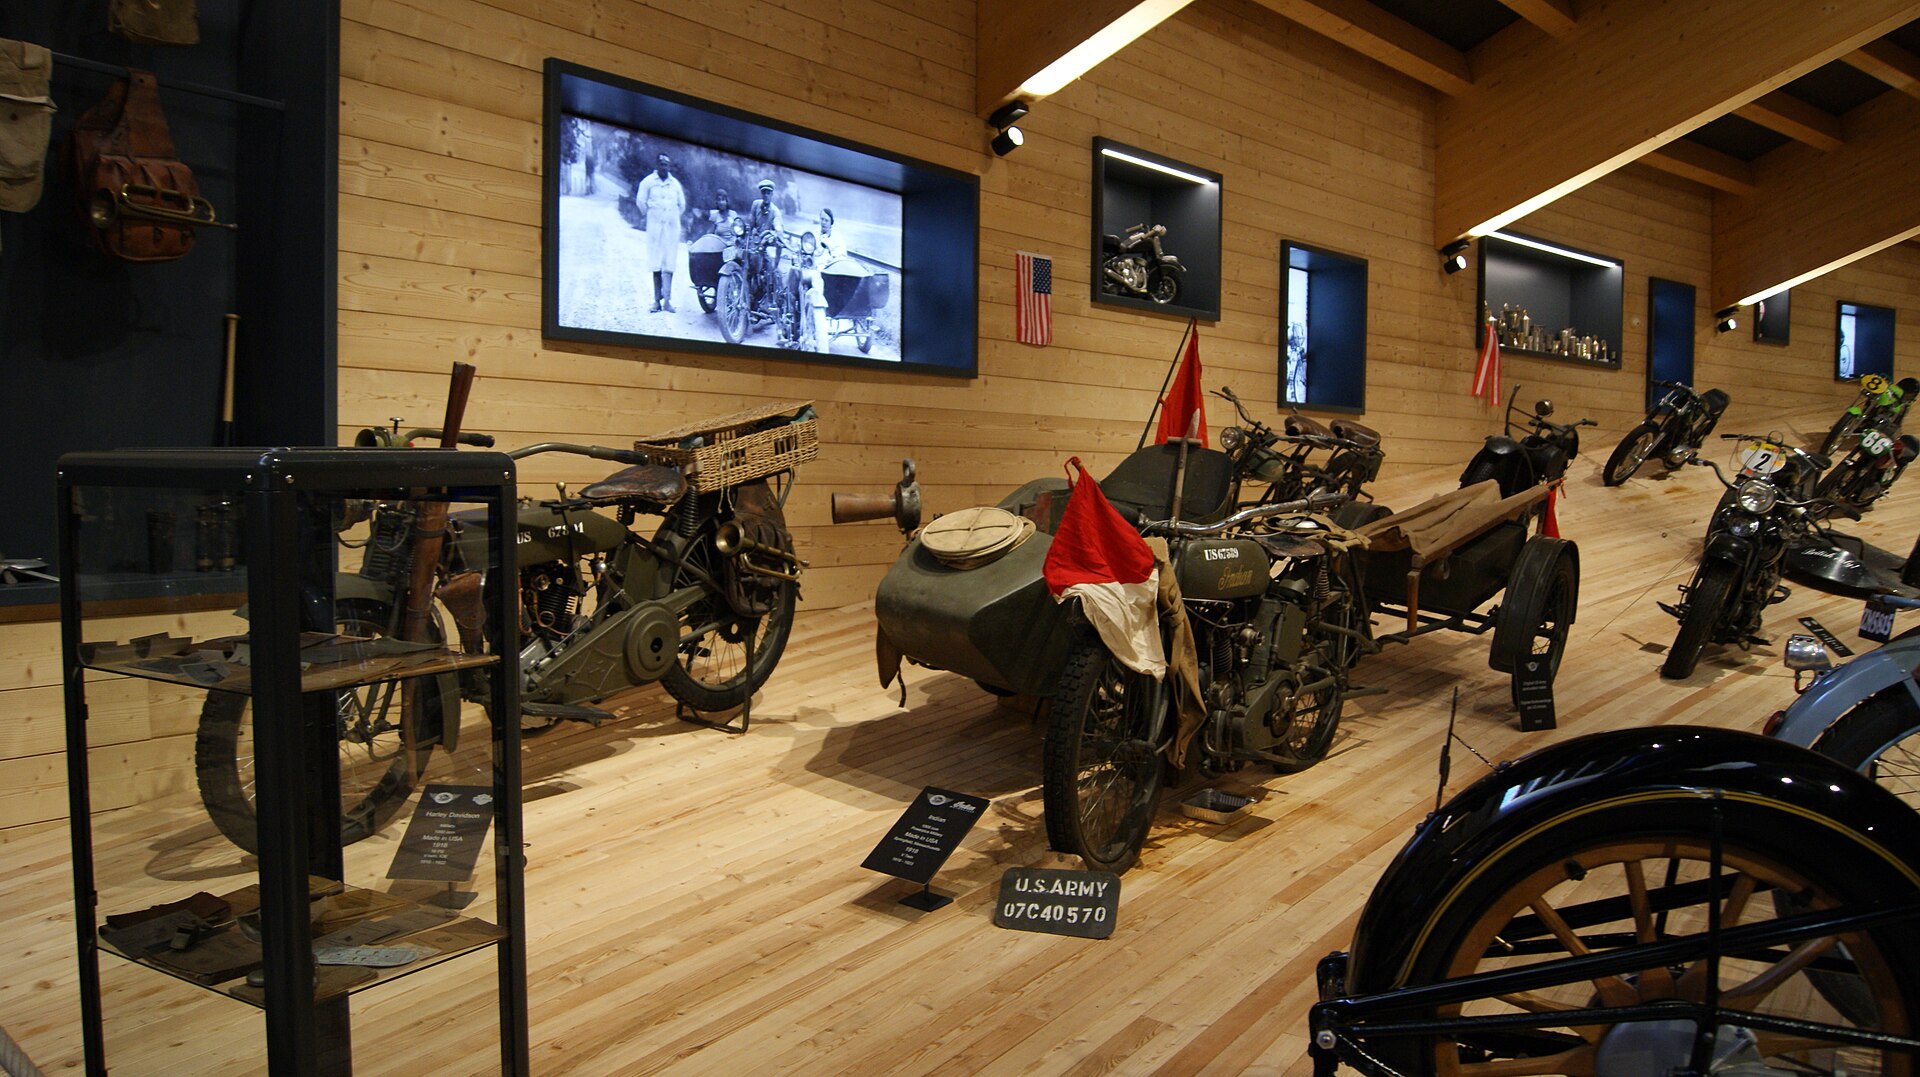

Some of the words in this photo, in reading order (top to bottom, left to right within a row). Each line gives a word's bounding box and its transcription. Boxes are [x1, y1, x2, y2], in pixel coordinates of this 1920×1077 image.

[1866, 377, 1883, 391] 8
[1861, 431, 1891, 455] 66
[1753, 453, 1772, 470] 2
[516, 531, 532, 545] US
[425, 811, 447, 819] Harley
[448, 811, 481, 819] Davidson
[927, 814, 947, 823] Indian
[904, 831, 920, 840] Made
[926, 837, 939, 845] USA
[1003, 902, 1107, 924] 07C40570
